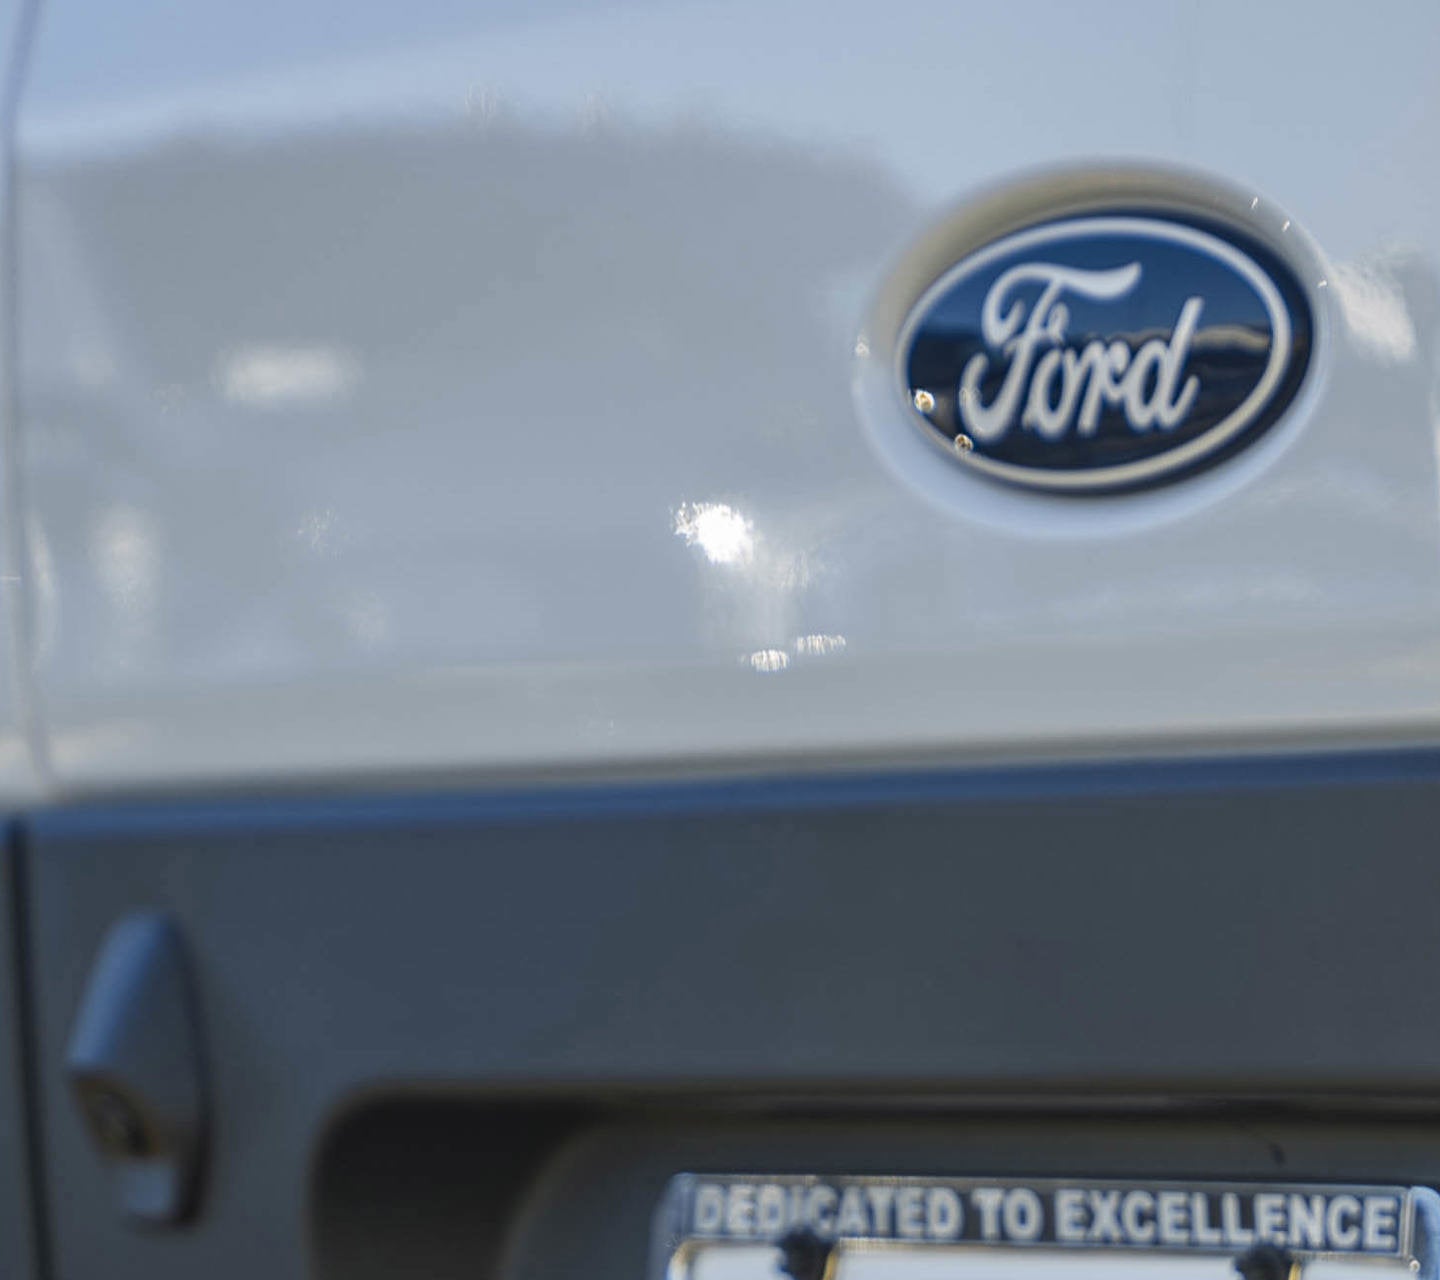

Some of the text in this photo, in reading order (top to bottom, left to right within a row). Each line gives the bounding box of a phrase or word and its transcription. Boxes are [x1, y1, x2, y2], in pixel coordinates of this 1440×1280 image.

[960, 260, 1203, 440] Ford
[695, 1184, 1397, 1250] DEDICATED TO EXCELLENCE
